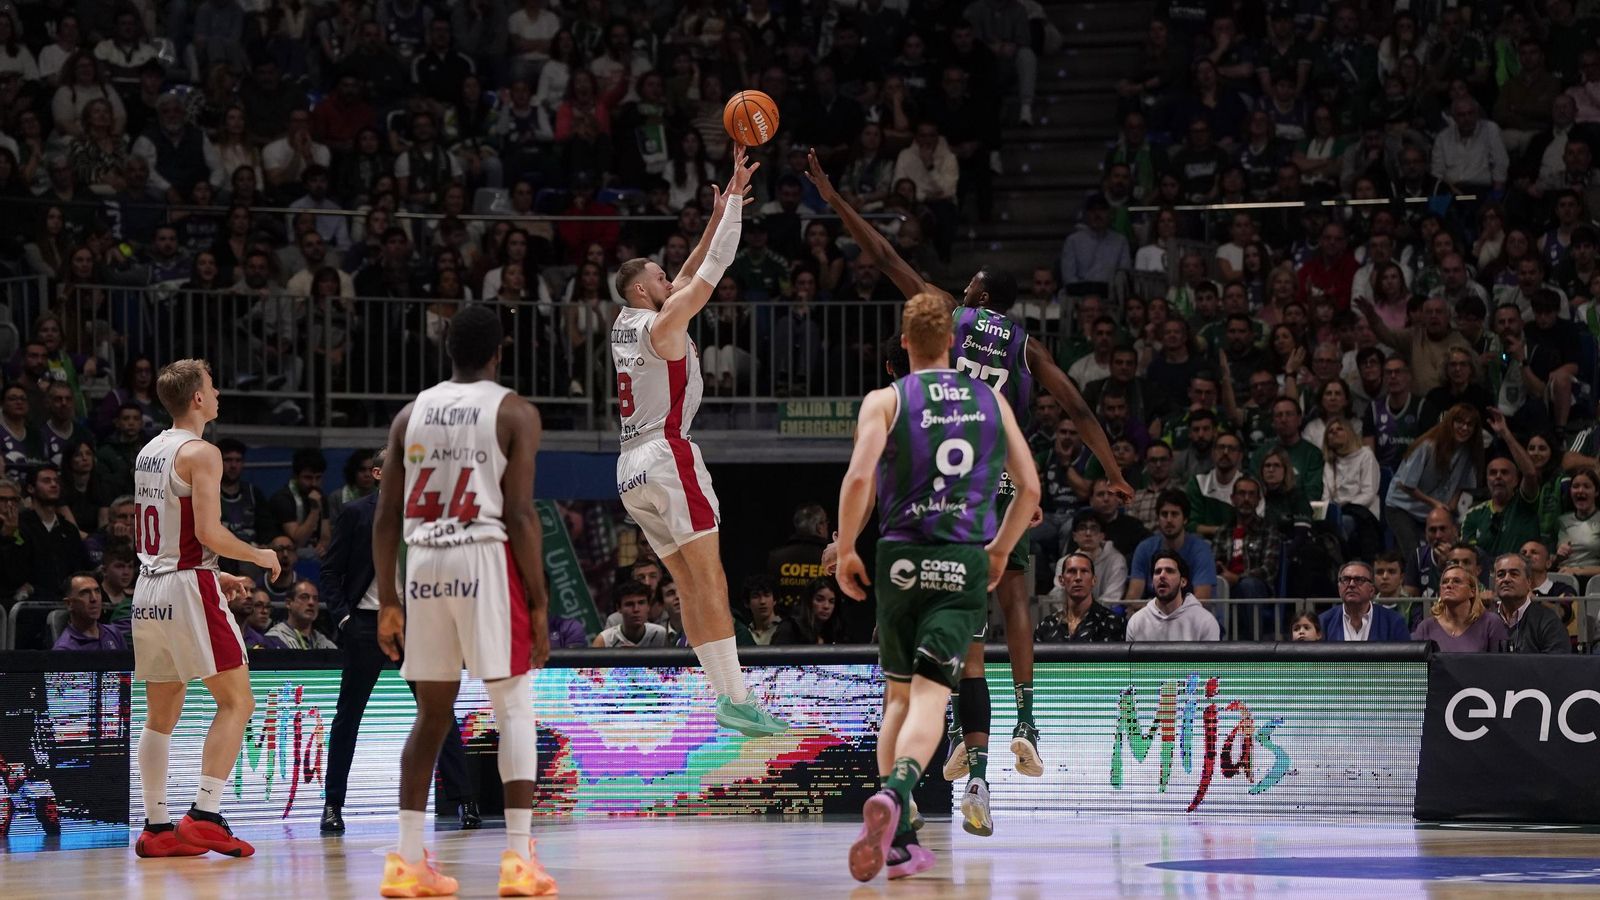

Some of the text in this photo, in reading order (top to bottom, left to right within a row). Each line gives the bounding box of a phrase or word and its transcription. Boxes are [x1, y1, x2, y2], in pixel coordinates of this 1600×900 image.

[975, 319, 1011, 340] Sima
[616, 357, 644, 366] MUTIO
[617, 372, 635, 418] 8
[424, 406, 481, 426] BALDWIN
[786, 401, 853, 417] SALIDA DE
[430, 447, 487, 464] AMUTIO
[933, 438, 975, 492] 9
[404, 467, 481, 523] 44
[135, 503, 160, 556] 10
[920, 559, 967, 576] COSTA
[920, 571, 966, 585] DEL SOL
[409, 578, 479, 600] Recalvi
[234, 680, 327, 820] Mija
[1110, 673, 1285, 813] Mijas
